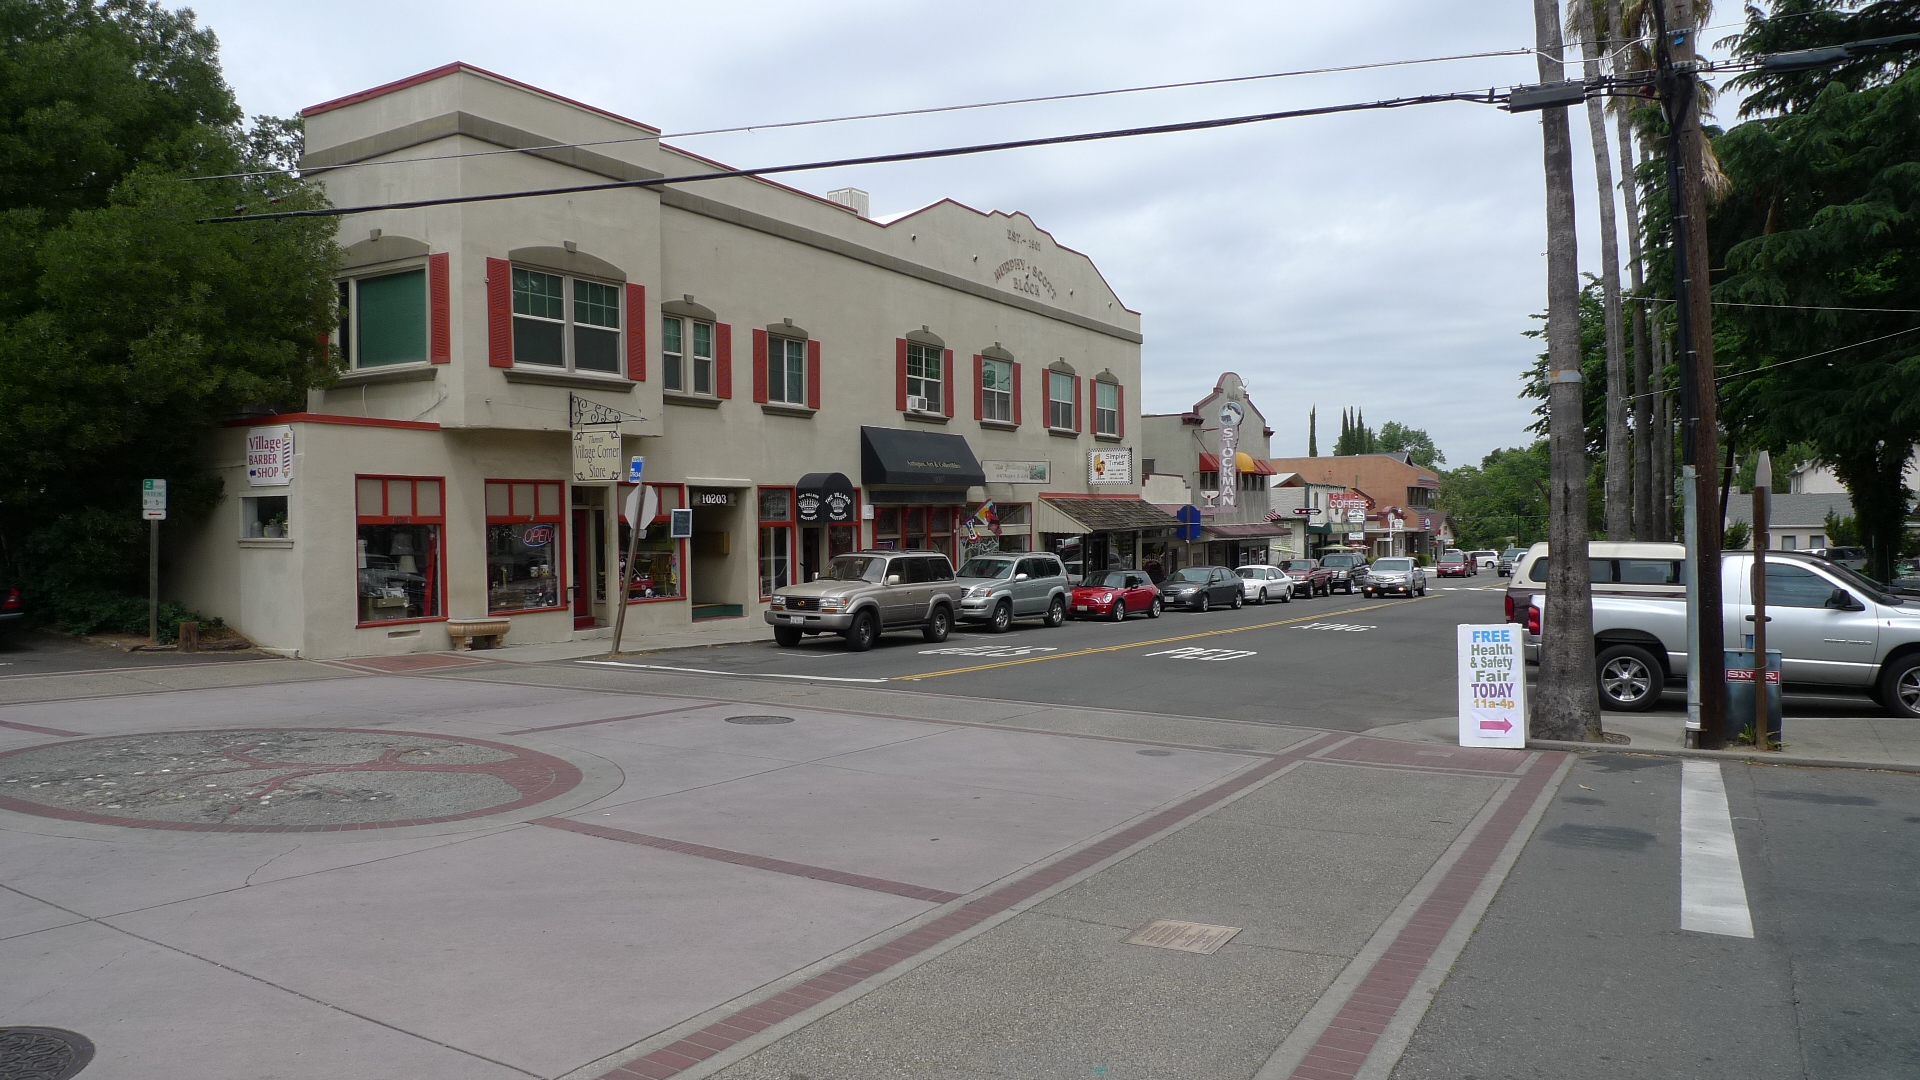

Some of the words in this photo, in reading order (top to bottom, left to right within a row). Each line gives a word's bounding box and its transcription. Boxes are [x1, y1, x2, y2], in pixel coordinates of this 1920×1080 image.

[994, 258, 1026, 284] MURPHY
[1032, 265, 1057, 300] SCOTT
[1012, 277, 1040, 298] BLOCK
[249, 435, 282, 454] Village
[574, 444, 596, 464] Village
[597, 444, 620, 459] Corner
[248, 453, 278, 466] BARBER
[257, 466, 279, 478] SHOP
[588, 463, 606, 478] Store
[1222, 427, 1235, 506] STOCKMAN
[145, 481, 152, 489] 2
[701, 493, 727, 504] 10203
[825, 494, 834, 504] THE
[834, 492, 851, 505] VILLAGE
[1329, 499, 1366, 509] COFFEE
[524, 528, 554, 543] OPEN
[1290, 622, 1378, 632] XING
[1472, 630, 1510, 643] FREE
[1143, 647, 1258, 661] PED
[1471, 643, 1513, 656] Health
[1470, 656, 1477, 668] &
[1480, 656, 1513, 671] Safety
[1475, 670, 1510, 682] Fair
[1727, 670, 1777, 680] SNR
[1471, 683, 1514, 698] TODAY
[1473, 699, 1515, 709] 11a-4p
